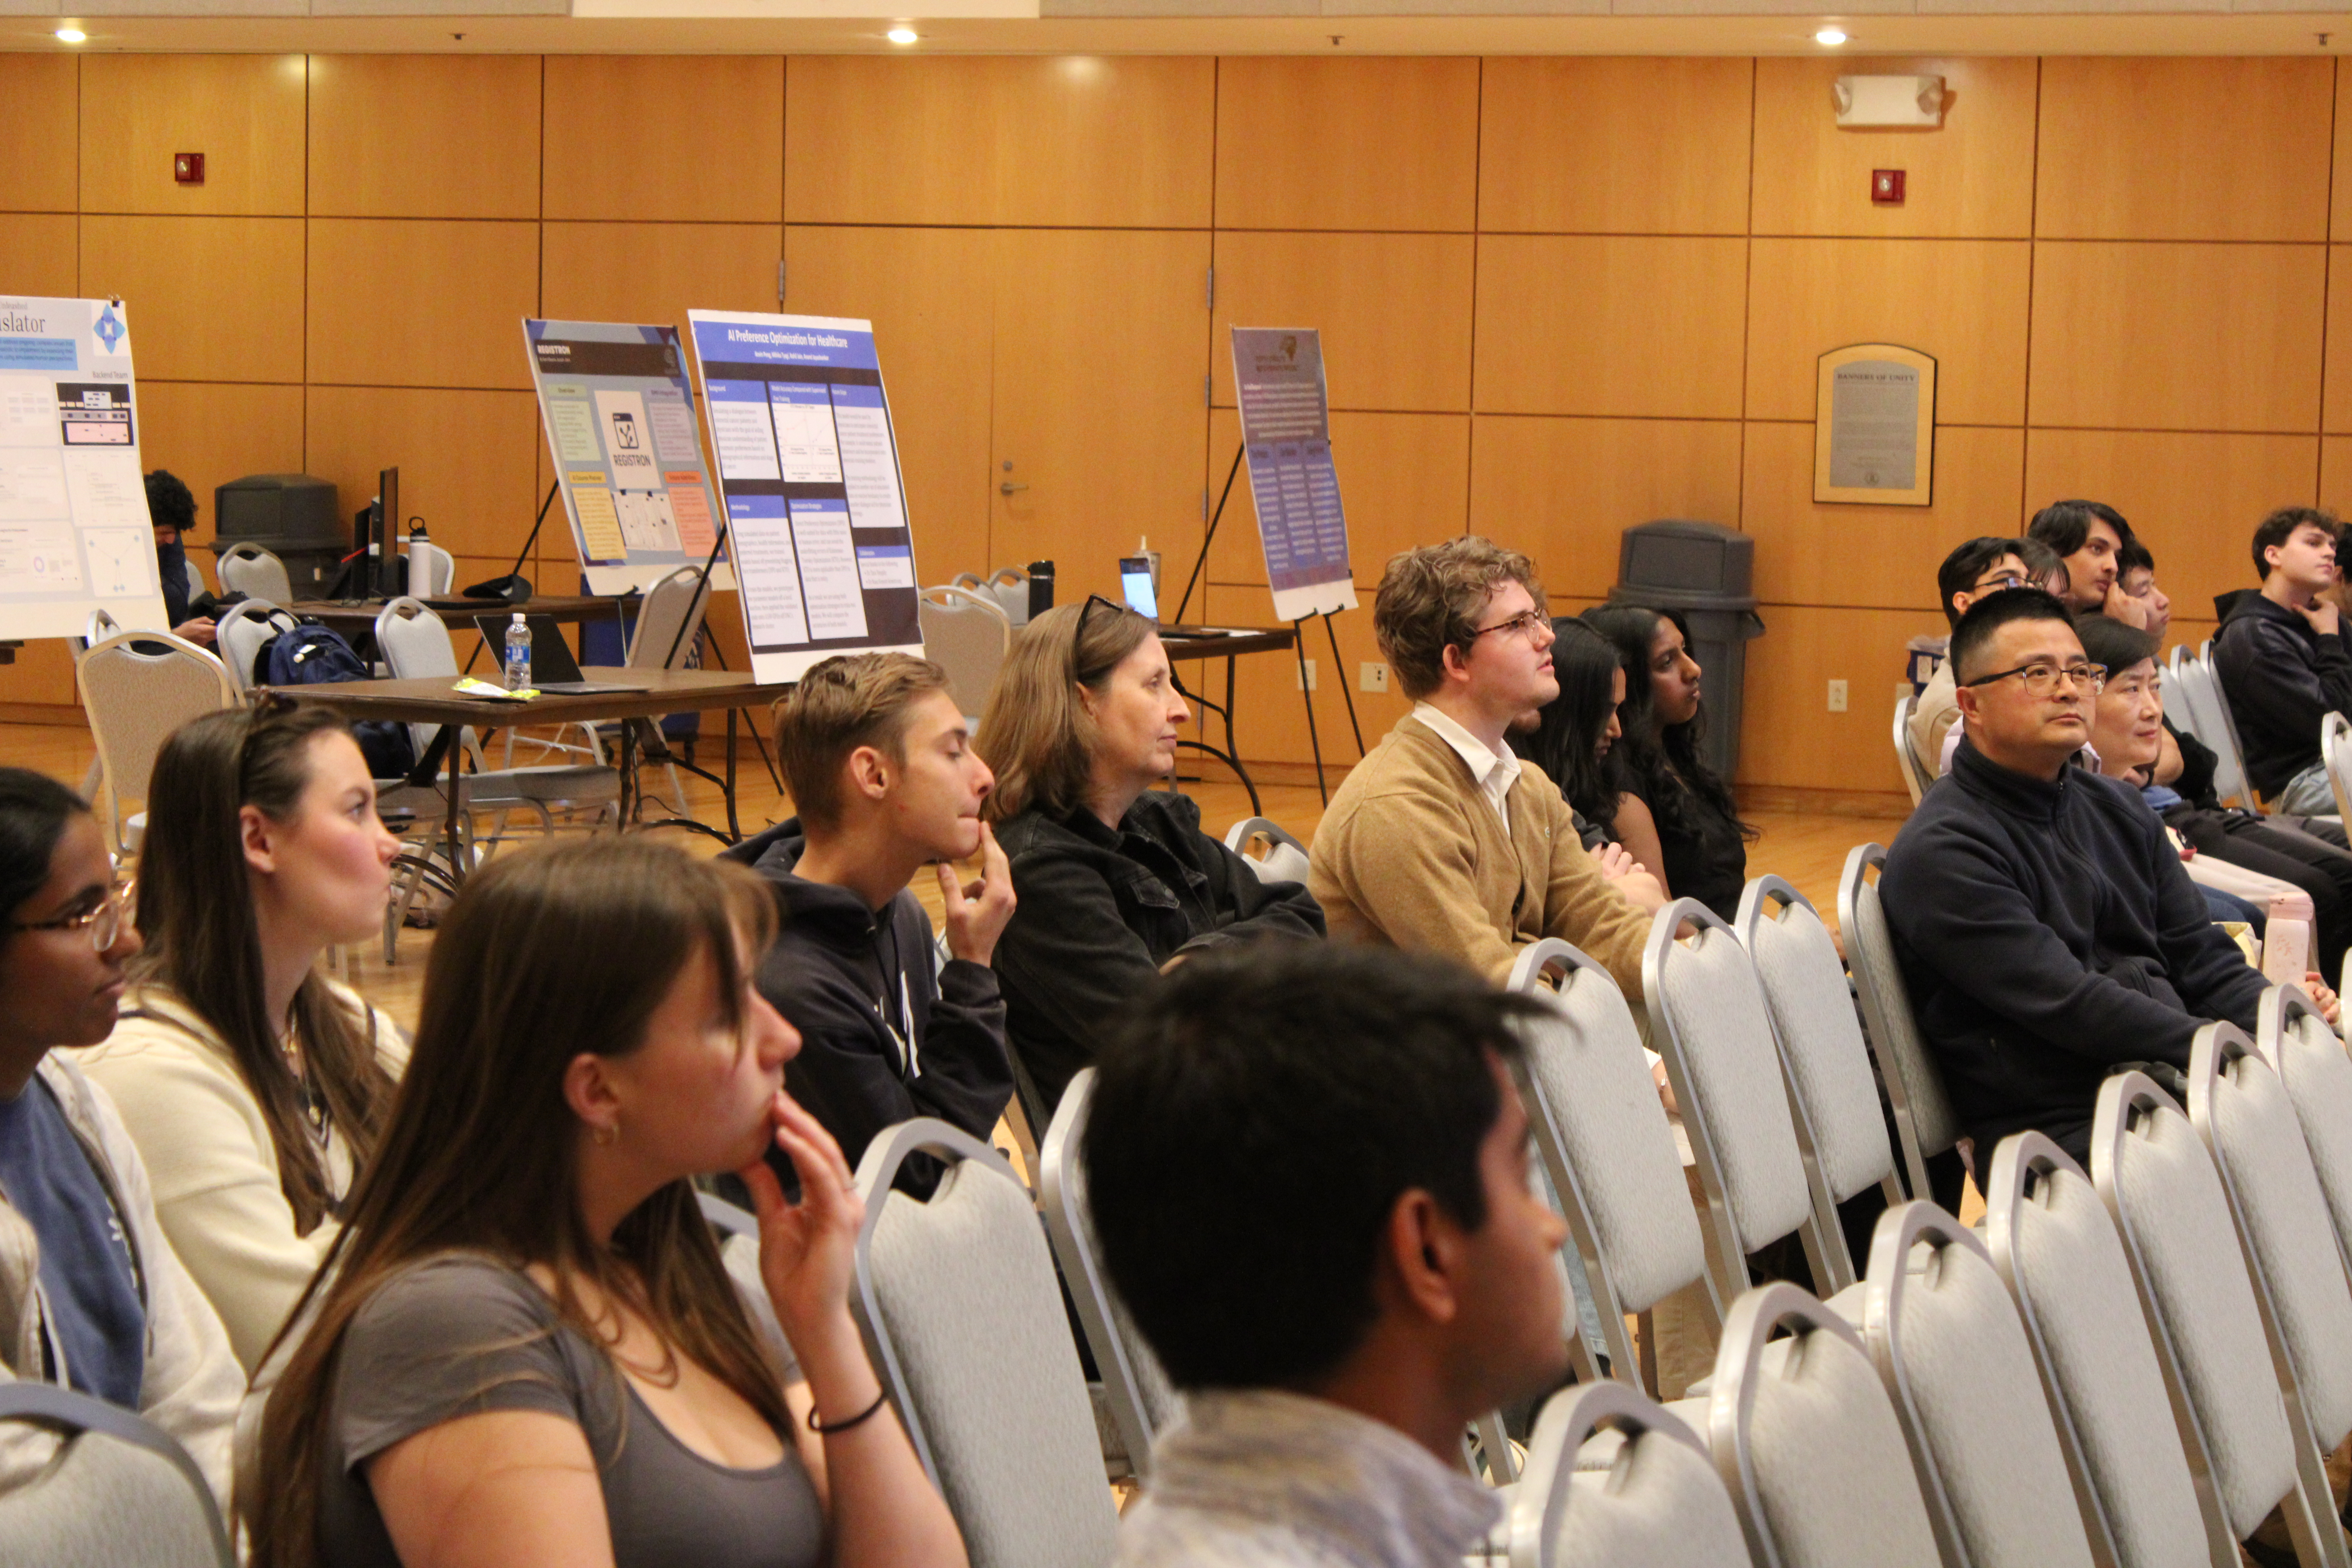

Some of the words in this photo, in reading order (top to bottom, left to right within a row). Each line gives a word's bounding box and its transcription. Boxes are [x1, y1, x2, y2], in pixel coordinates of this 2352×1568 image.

[0, 301, 27, 310] nleashed
[0, 311, 45, 332] slator
[728, 329, 735, 341] AI
[736, 330, 769, 343] Preference
[769, 332, 808, 347] Optimization
[808, 334, 817, 346] for
[817, 335, 848, 348] Healthcare
[613, 454, 651, 466] REGISTRON
